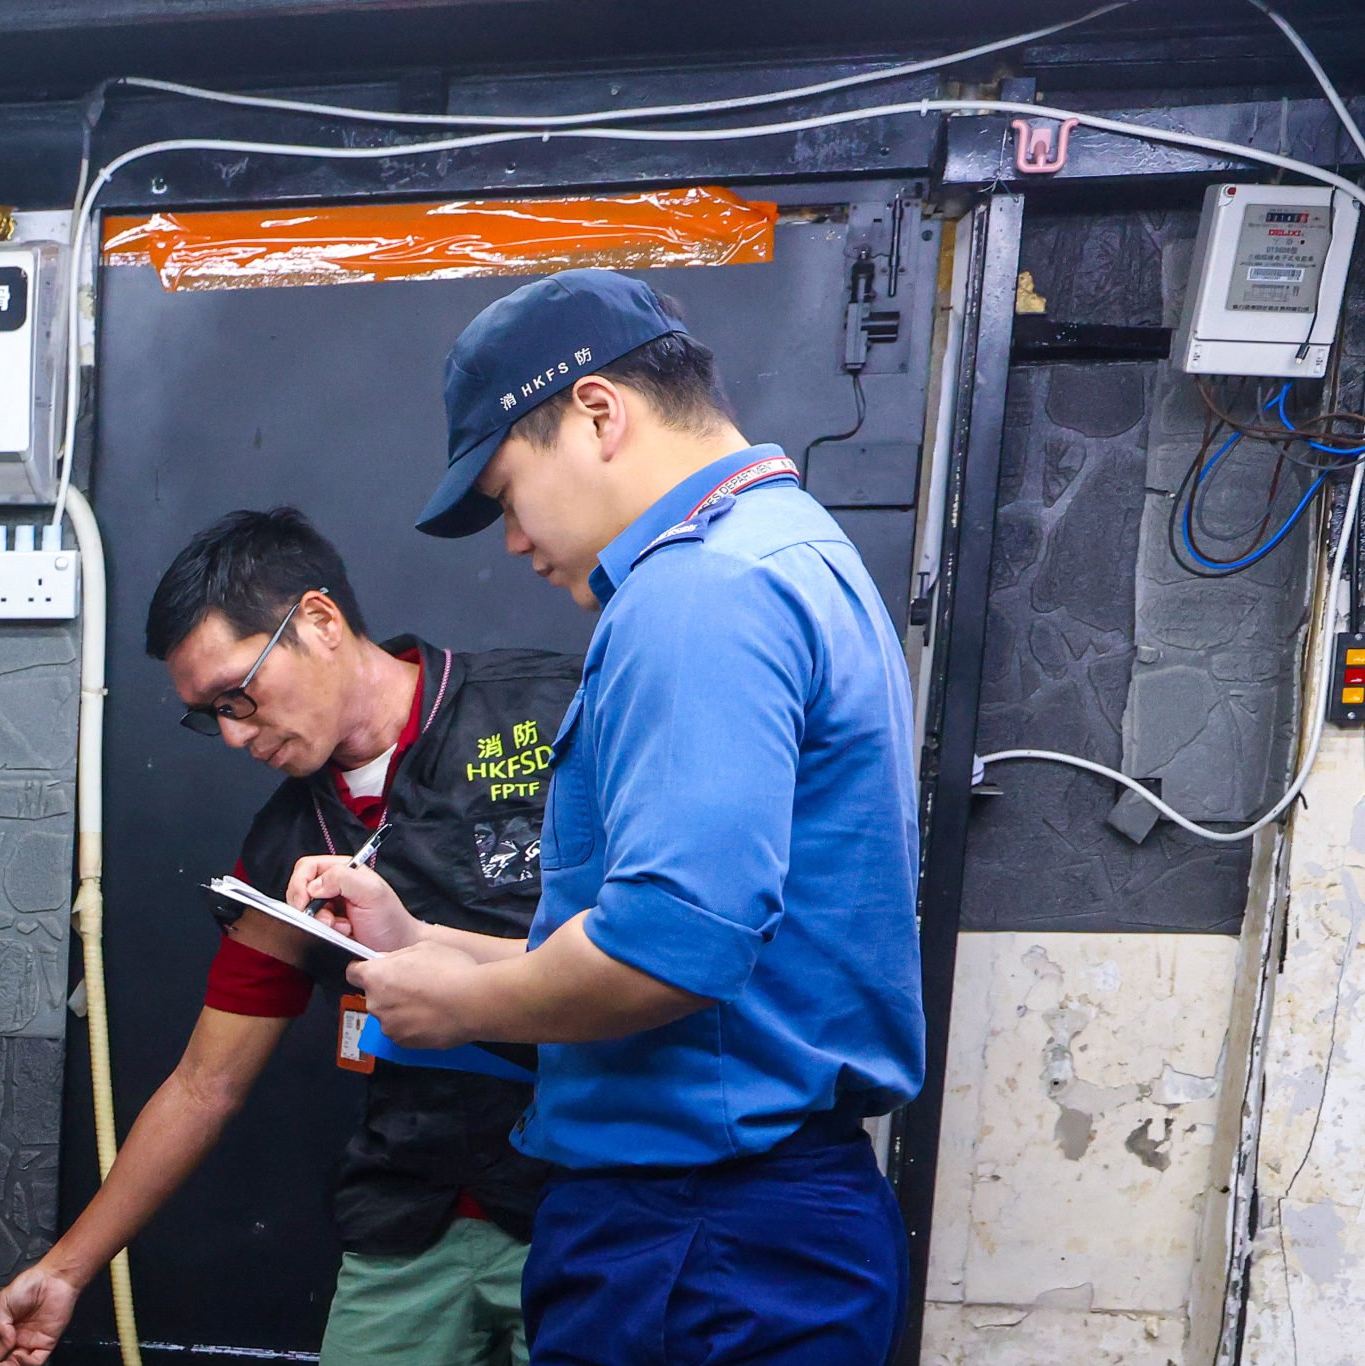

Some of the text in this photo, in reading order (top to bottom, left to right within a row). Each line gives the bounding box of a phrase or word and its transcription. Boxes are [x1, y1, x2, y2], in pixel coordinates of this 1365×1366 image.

[500, 347, 592, 411] 消 HKFS 防
[477, 720, 538, 759] 消防
[466, 745, 554, 781] HKFSD
[490, 782, 540, 801] FPTF
